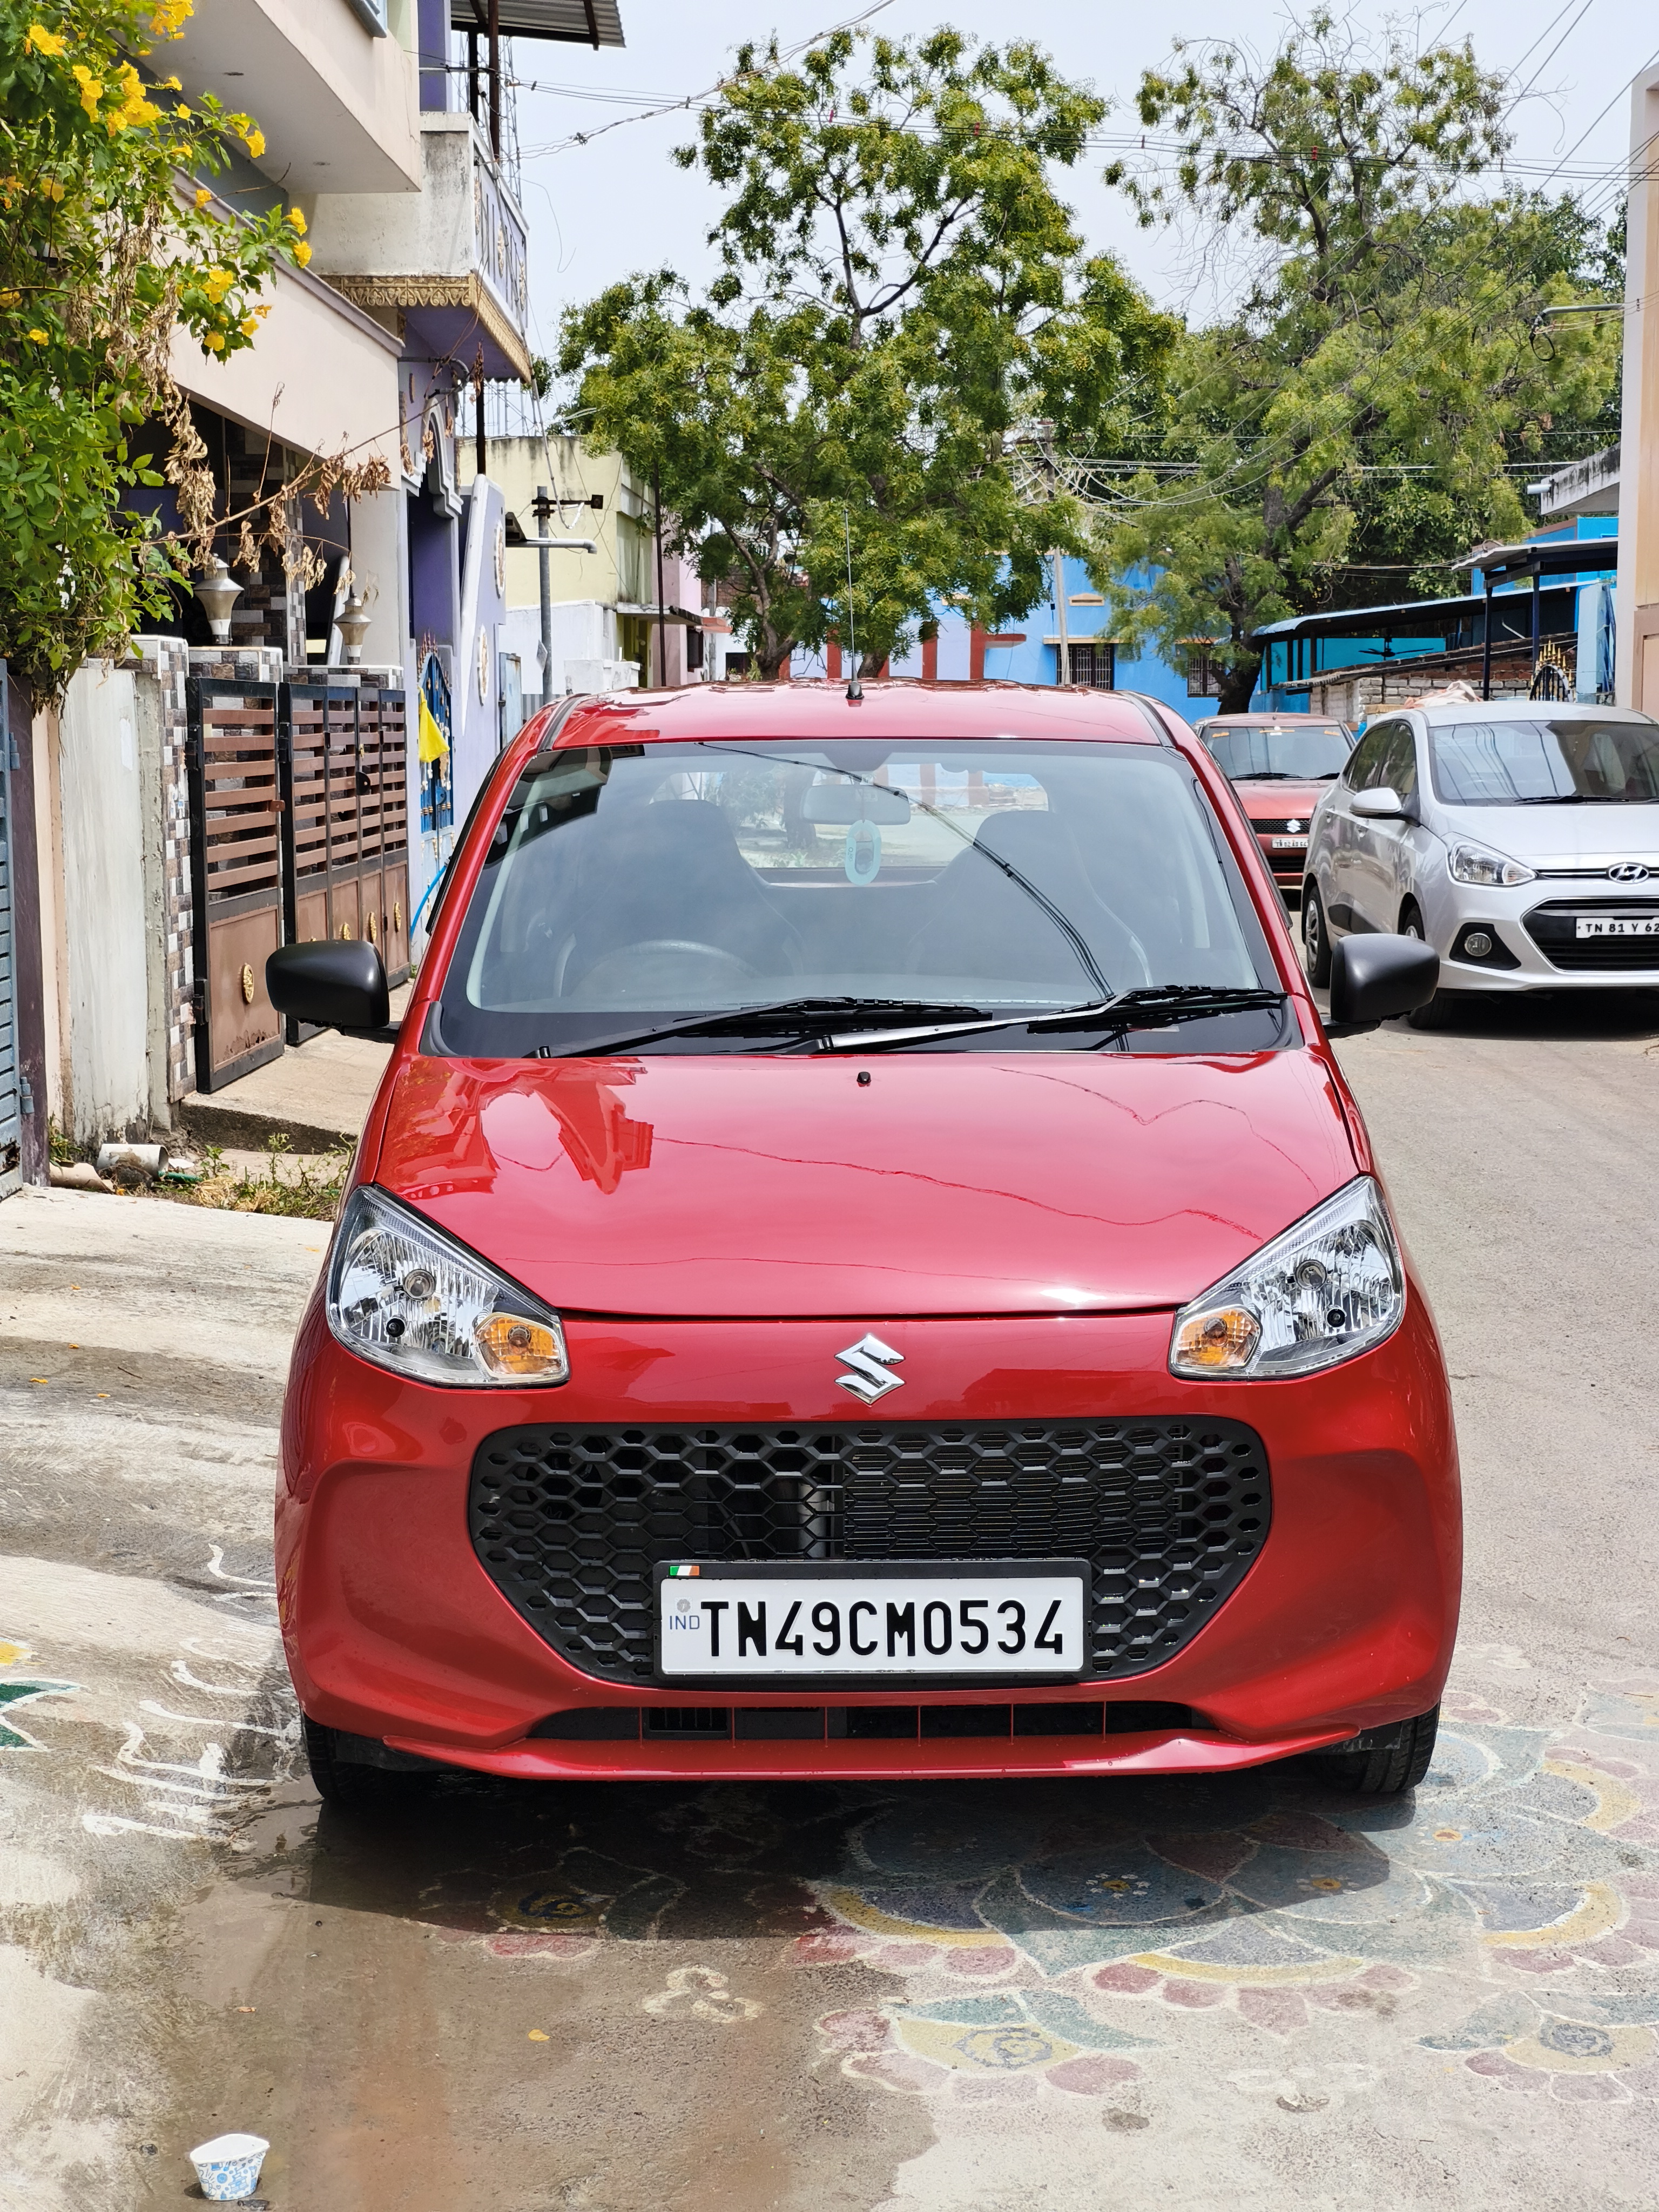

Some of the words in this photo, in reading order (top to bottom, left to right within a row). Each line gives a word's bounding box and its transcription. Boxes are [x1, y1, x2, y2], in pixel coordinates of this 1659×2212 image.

[1586, 923, 1602, 933] TN
[1609, 923, 1624, 932] 81
[1631, 923, 1638, 932] Y
[670, 1615, 700, 1630] IND
[700, 1600, 1063, 1657] TN49CM0534
